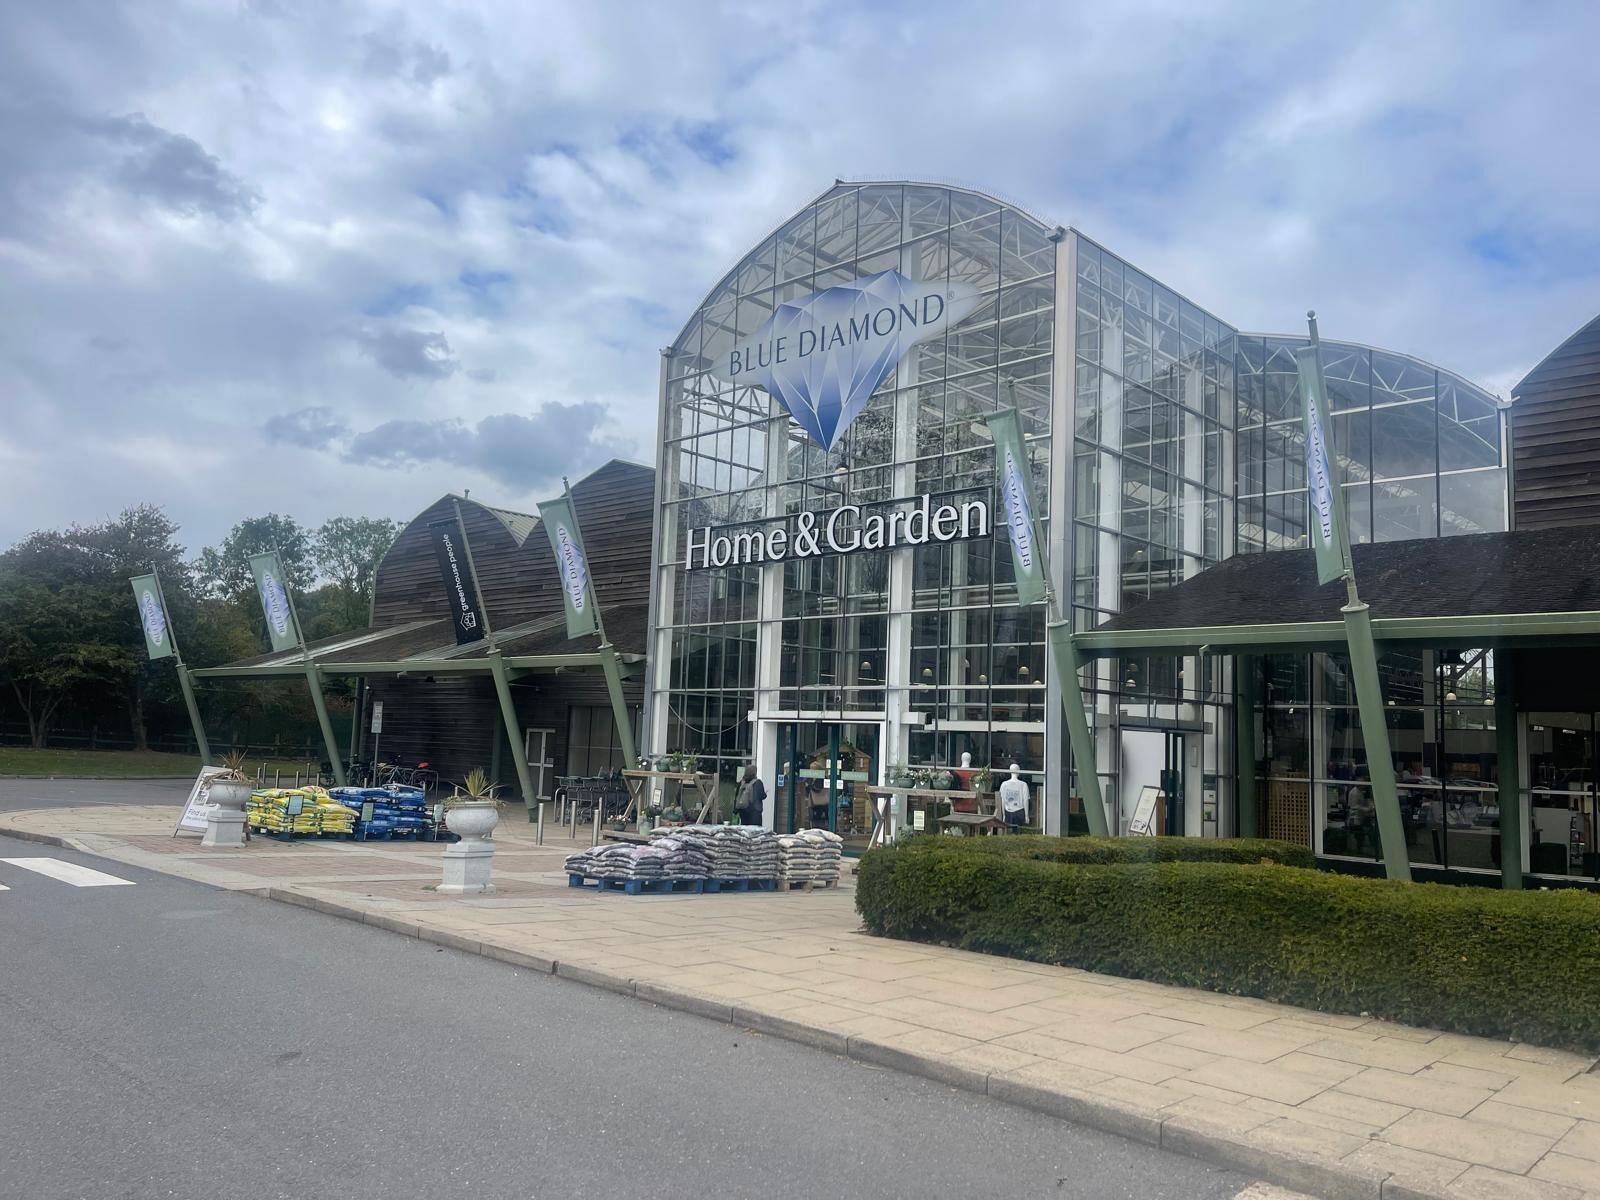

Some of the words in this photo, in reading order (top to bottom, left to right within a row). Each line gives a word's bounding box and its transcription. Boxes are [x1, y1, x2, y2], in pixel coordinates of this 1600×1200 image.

[729, 336, 787, 377] BLUE
[798, 293, 945, 358] DIAMOND
[443, 533, 457, 563] people
[558, 527, 578, 580] DIAMOND
[685, 526, 787, 571] Home
[826, 492, 989, 554] Garden
[451, 562, 469, 612] greenhouse
[572, 582, 583, 609] BLUE
[187, 808, 200, 817] Find
